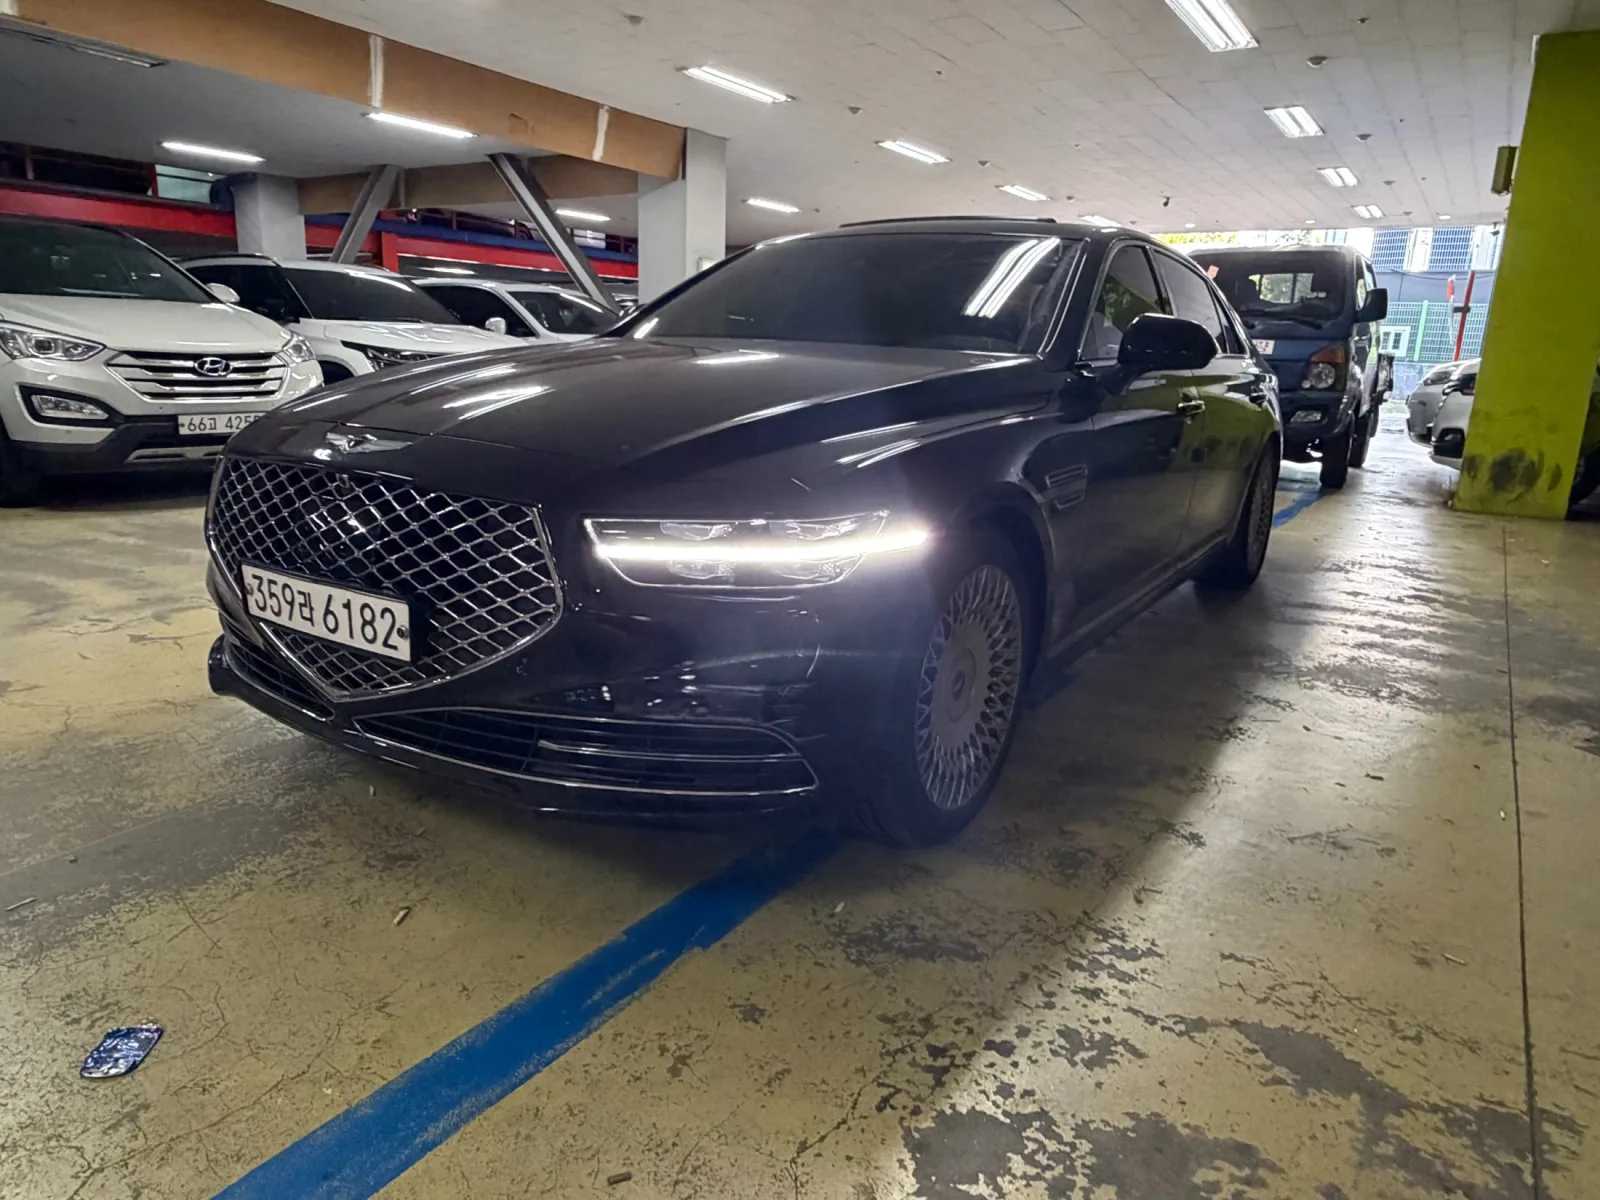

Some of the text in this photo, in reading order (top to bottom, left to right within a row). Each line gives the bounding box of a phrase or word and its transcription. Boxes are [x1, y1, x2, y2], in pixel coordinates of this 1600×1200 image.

[187, 416, 217, 432] 66고
[252, 574, 398, 651] 359라 6182
